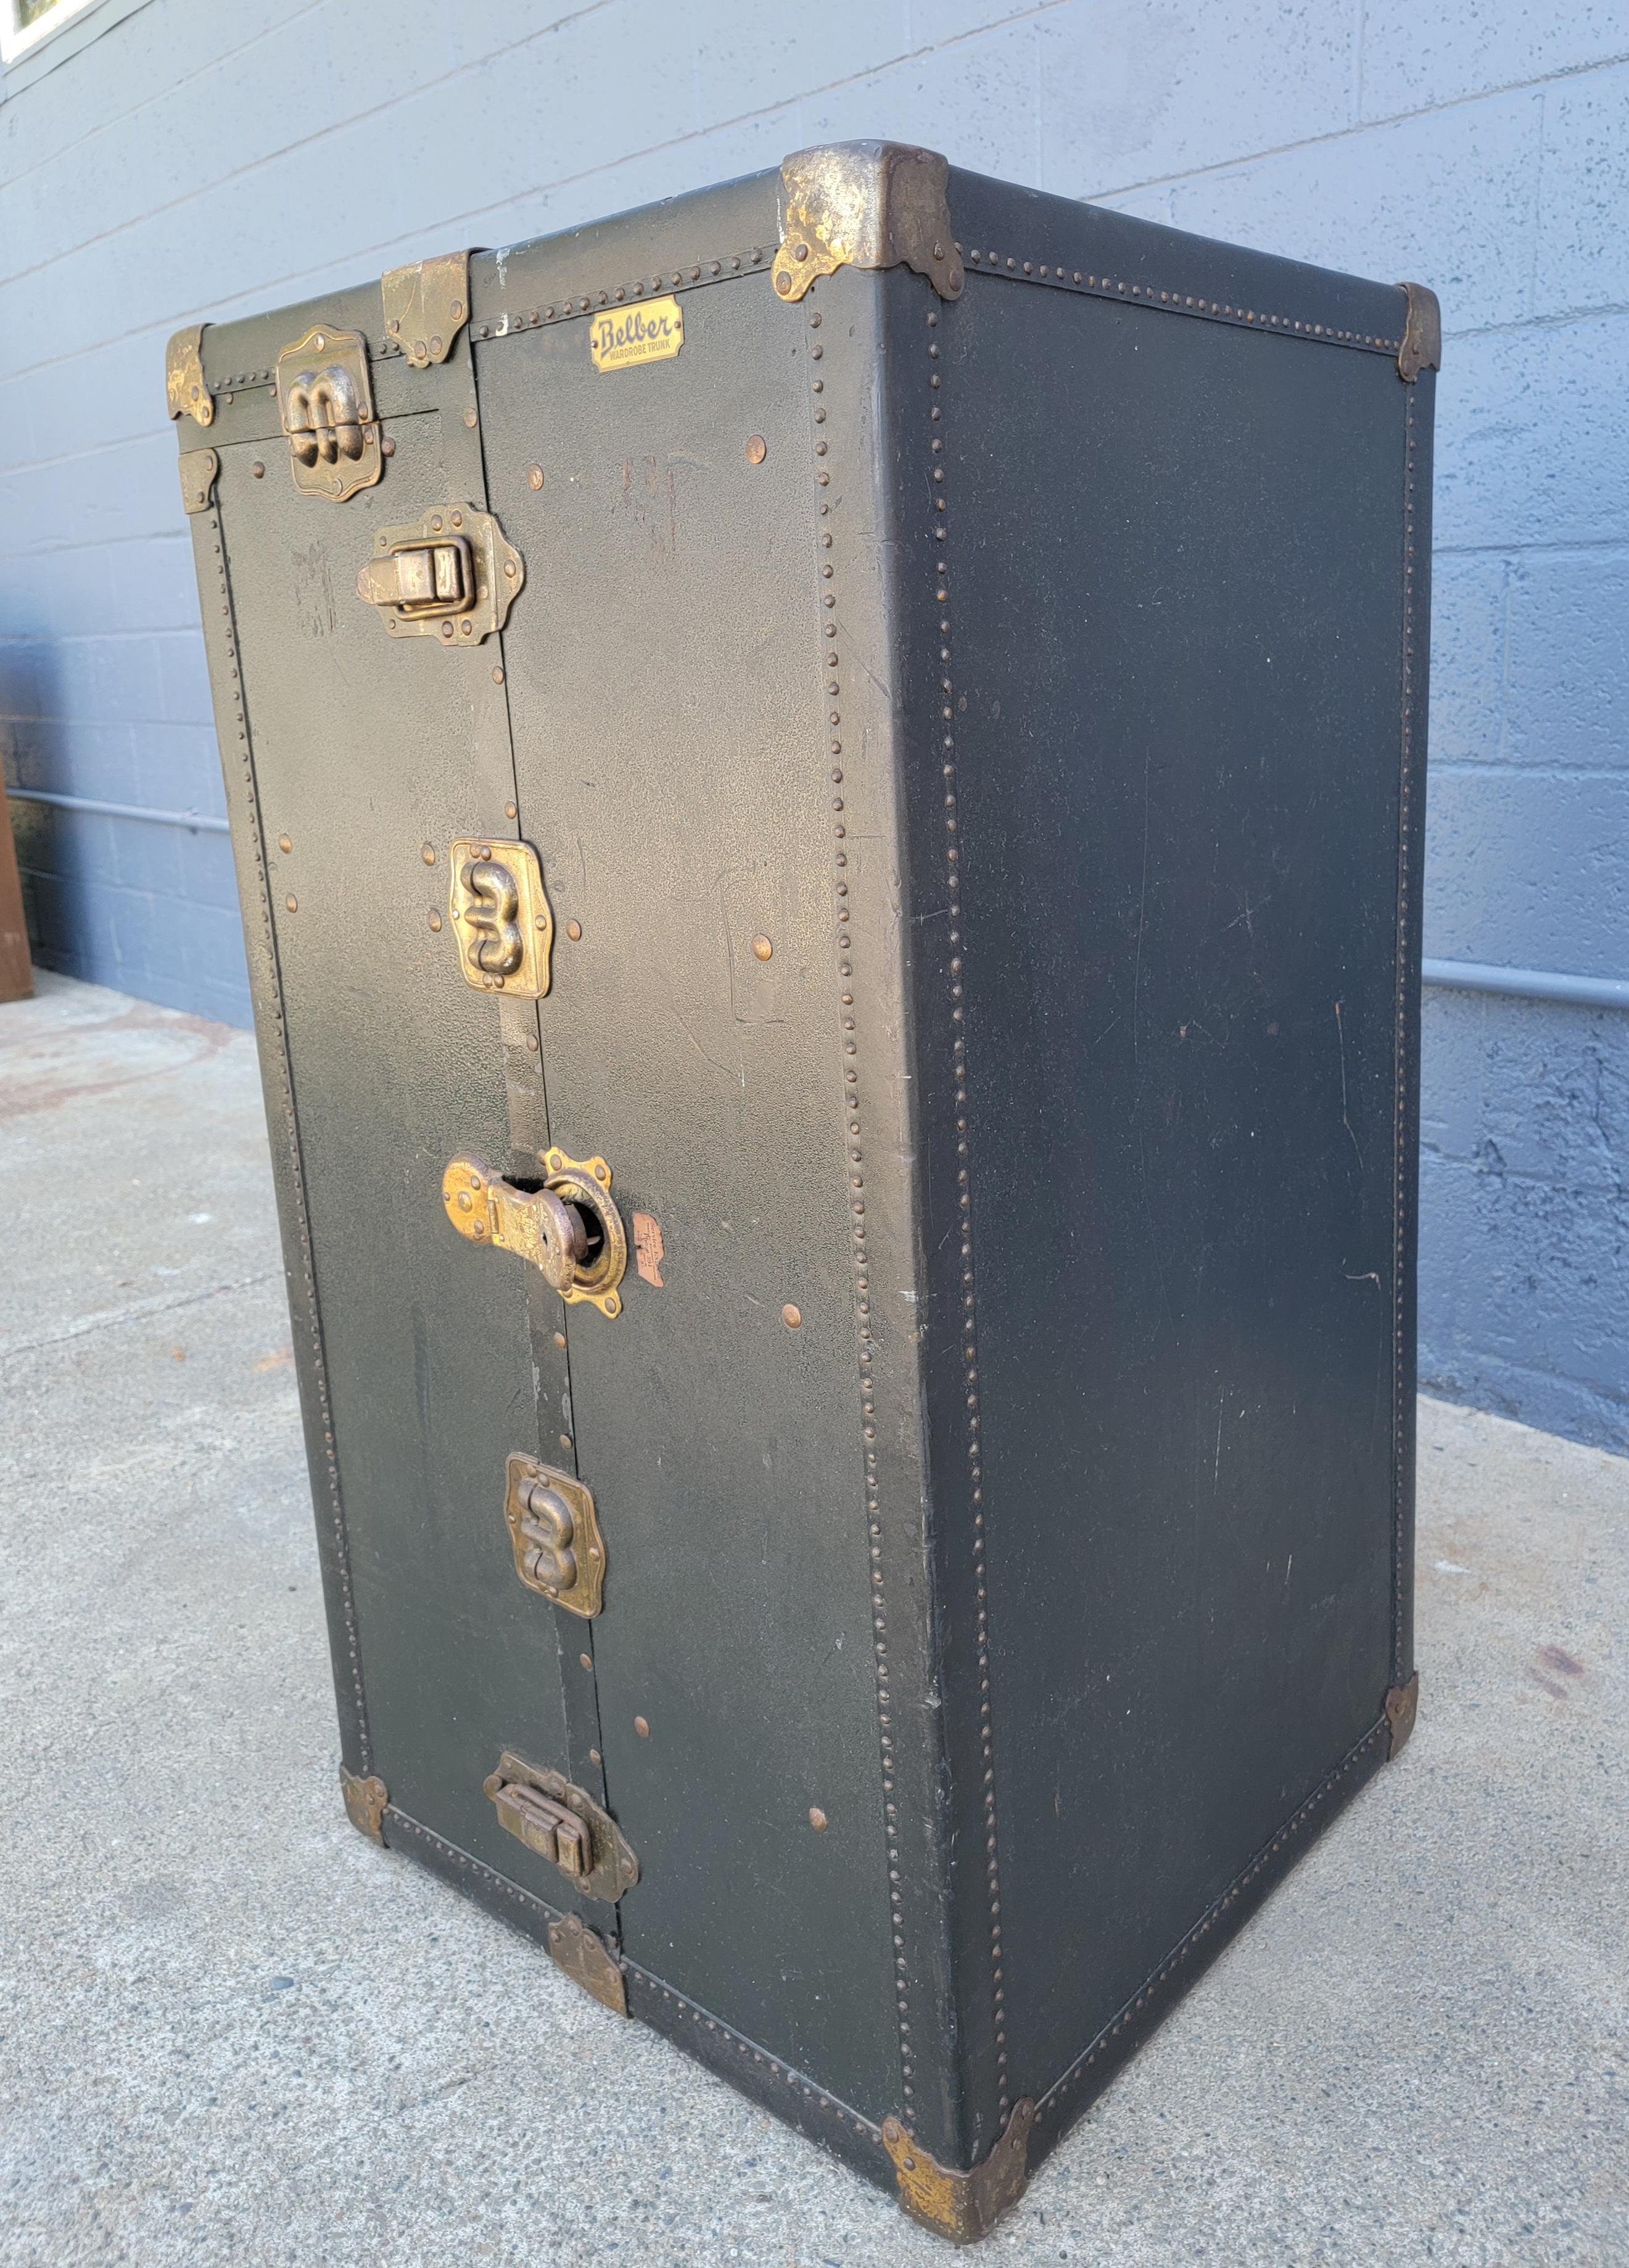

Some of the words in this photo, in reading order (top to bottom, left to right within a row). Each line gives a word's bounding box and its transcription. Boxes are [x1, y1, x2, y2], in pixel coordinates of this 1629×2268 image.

[598, 312, 672, 360] Belber
[609, 344, 646, 360] WARDROBE
[648, 339, 670, 352] TRUNK
